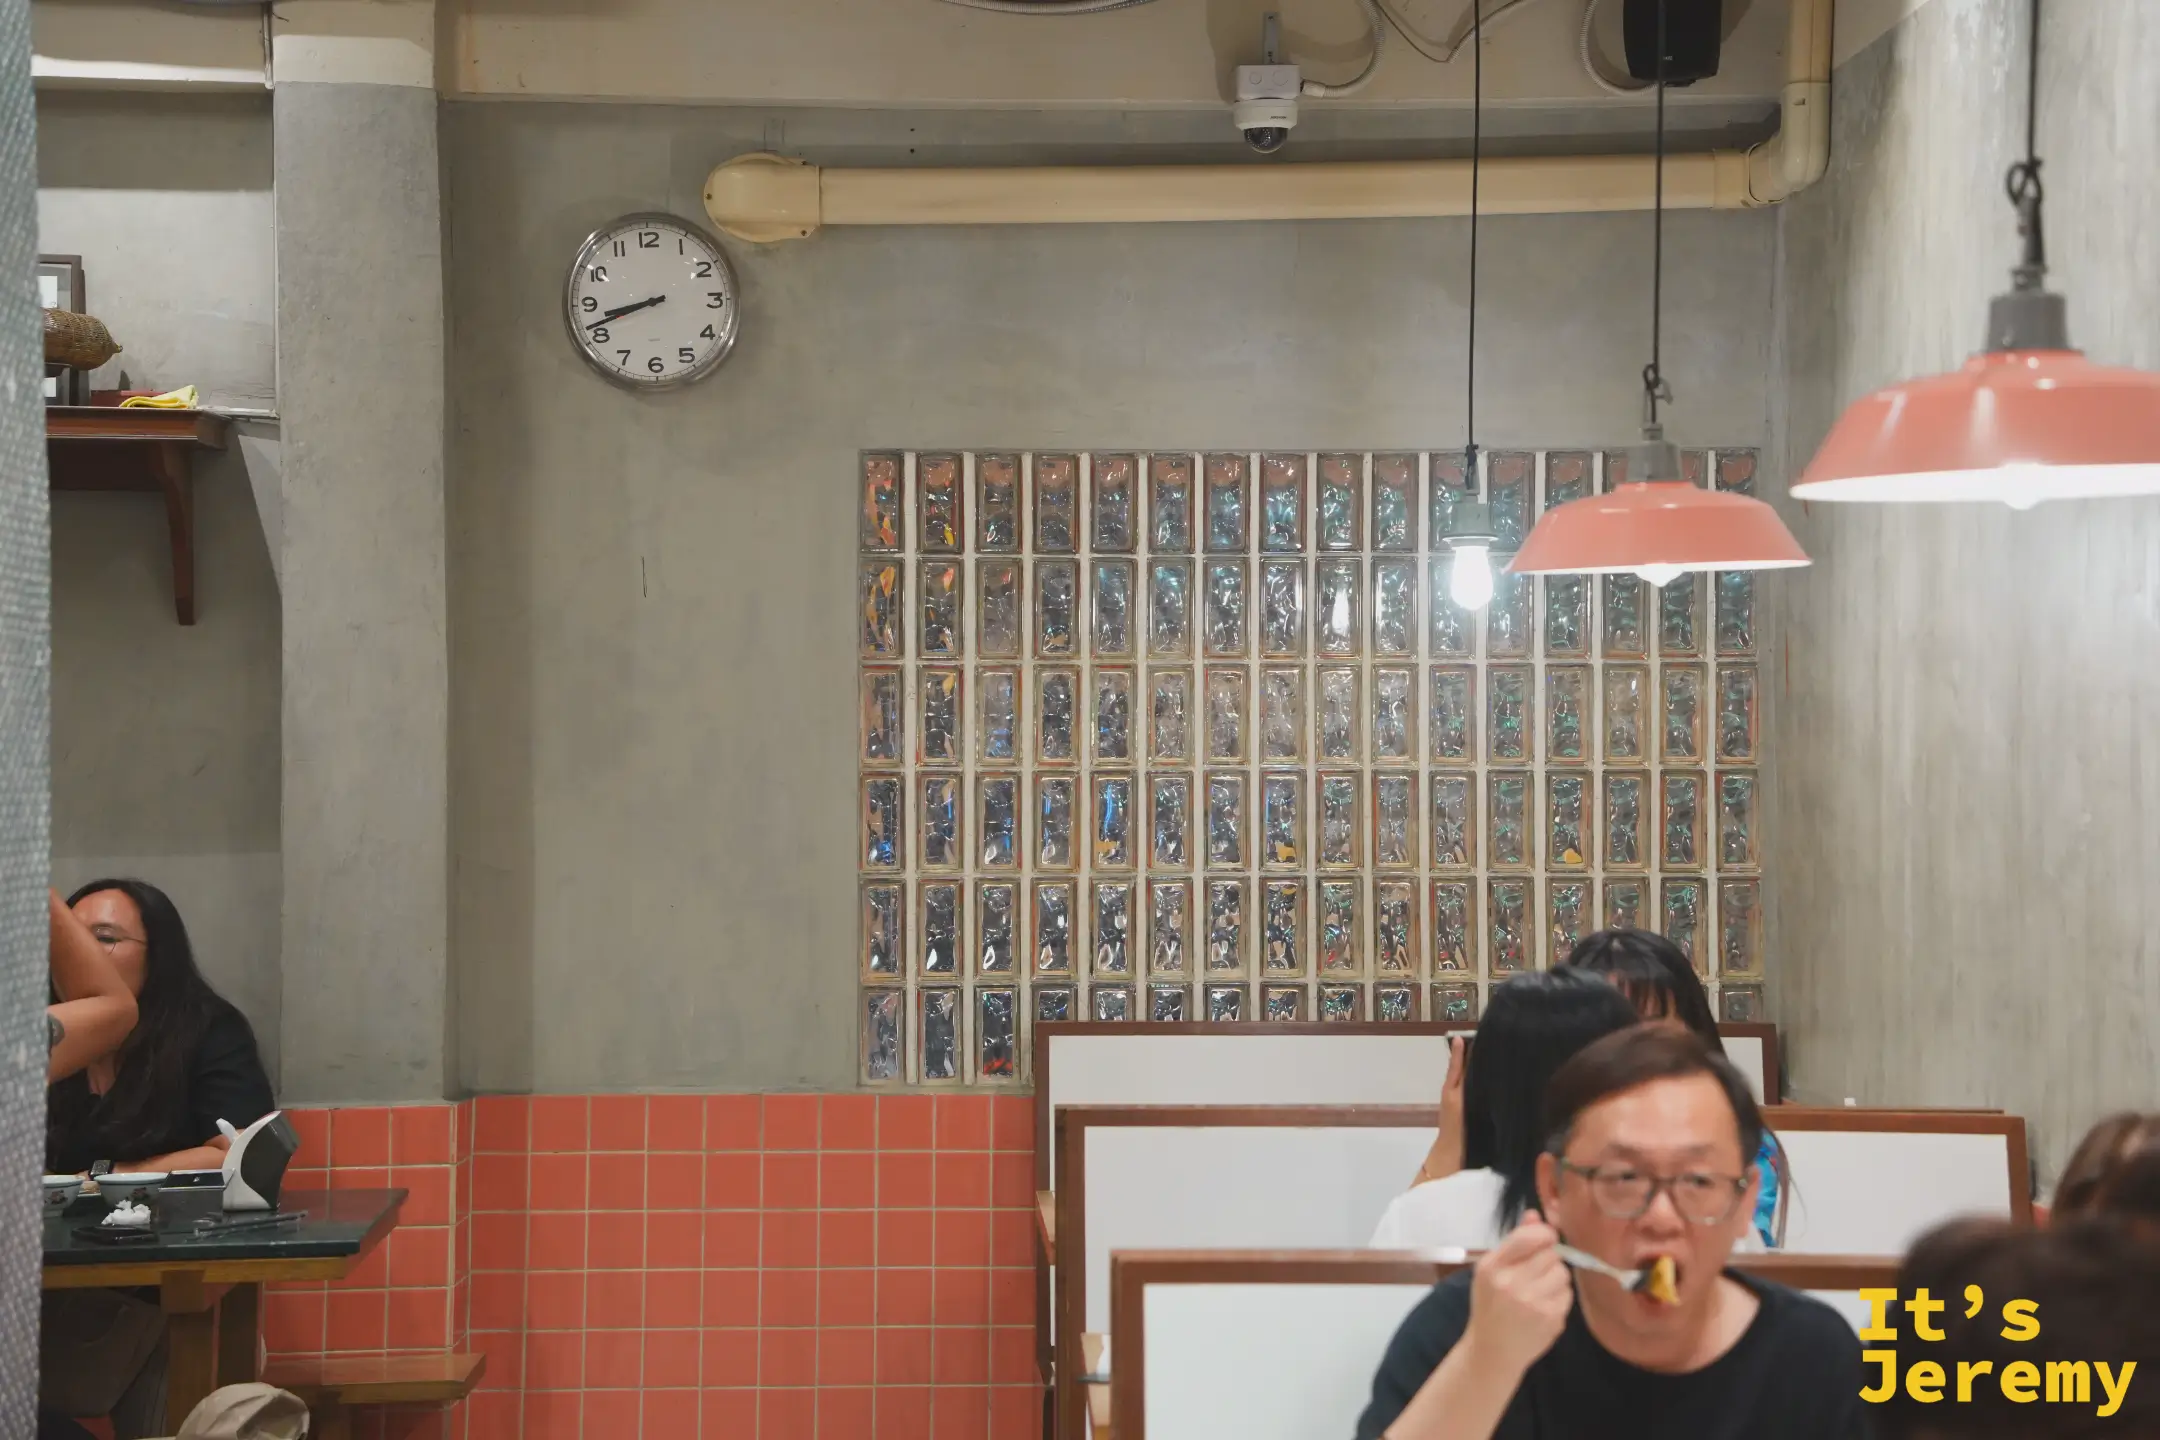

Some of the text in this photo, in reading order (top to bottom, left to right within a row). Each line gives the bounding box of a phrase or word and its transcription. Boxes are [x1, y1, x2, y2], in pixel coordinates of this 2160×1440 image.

[613, 240, 626, 257] 11
[638, 231, 660, 249] 12
[678, 238, 684, 256] 1
[590, 265, 607, 283] 10
[695, 261, 712, 278] 2
[581, 296, 598, 313] 9
[706, 292, 724, 309] 3
[592, 327, 610, 344] 8
[699, 324, 716, 340] 4
[616, 349, 631, 366] 7
[678, 347, 696, 364] 5
[647, 356, 665, 373] 6
